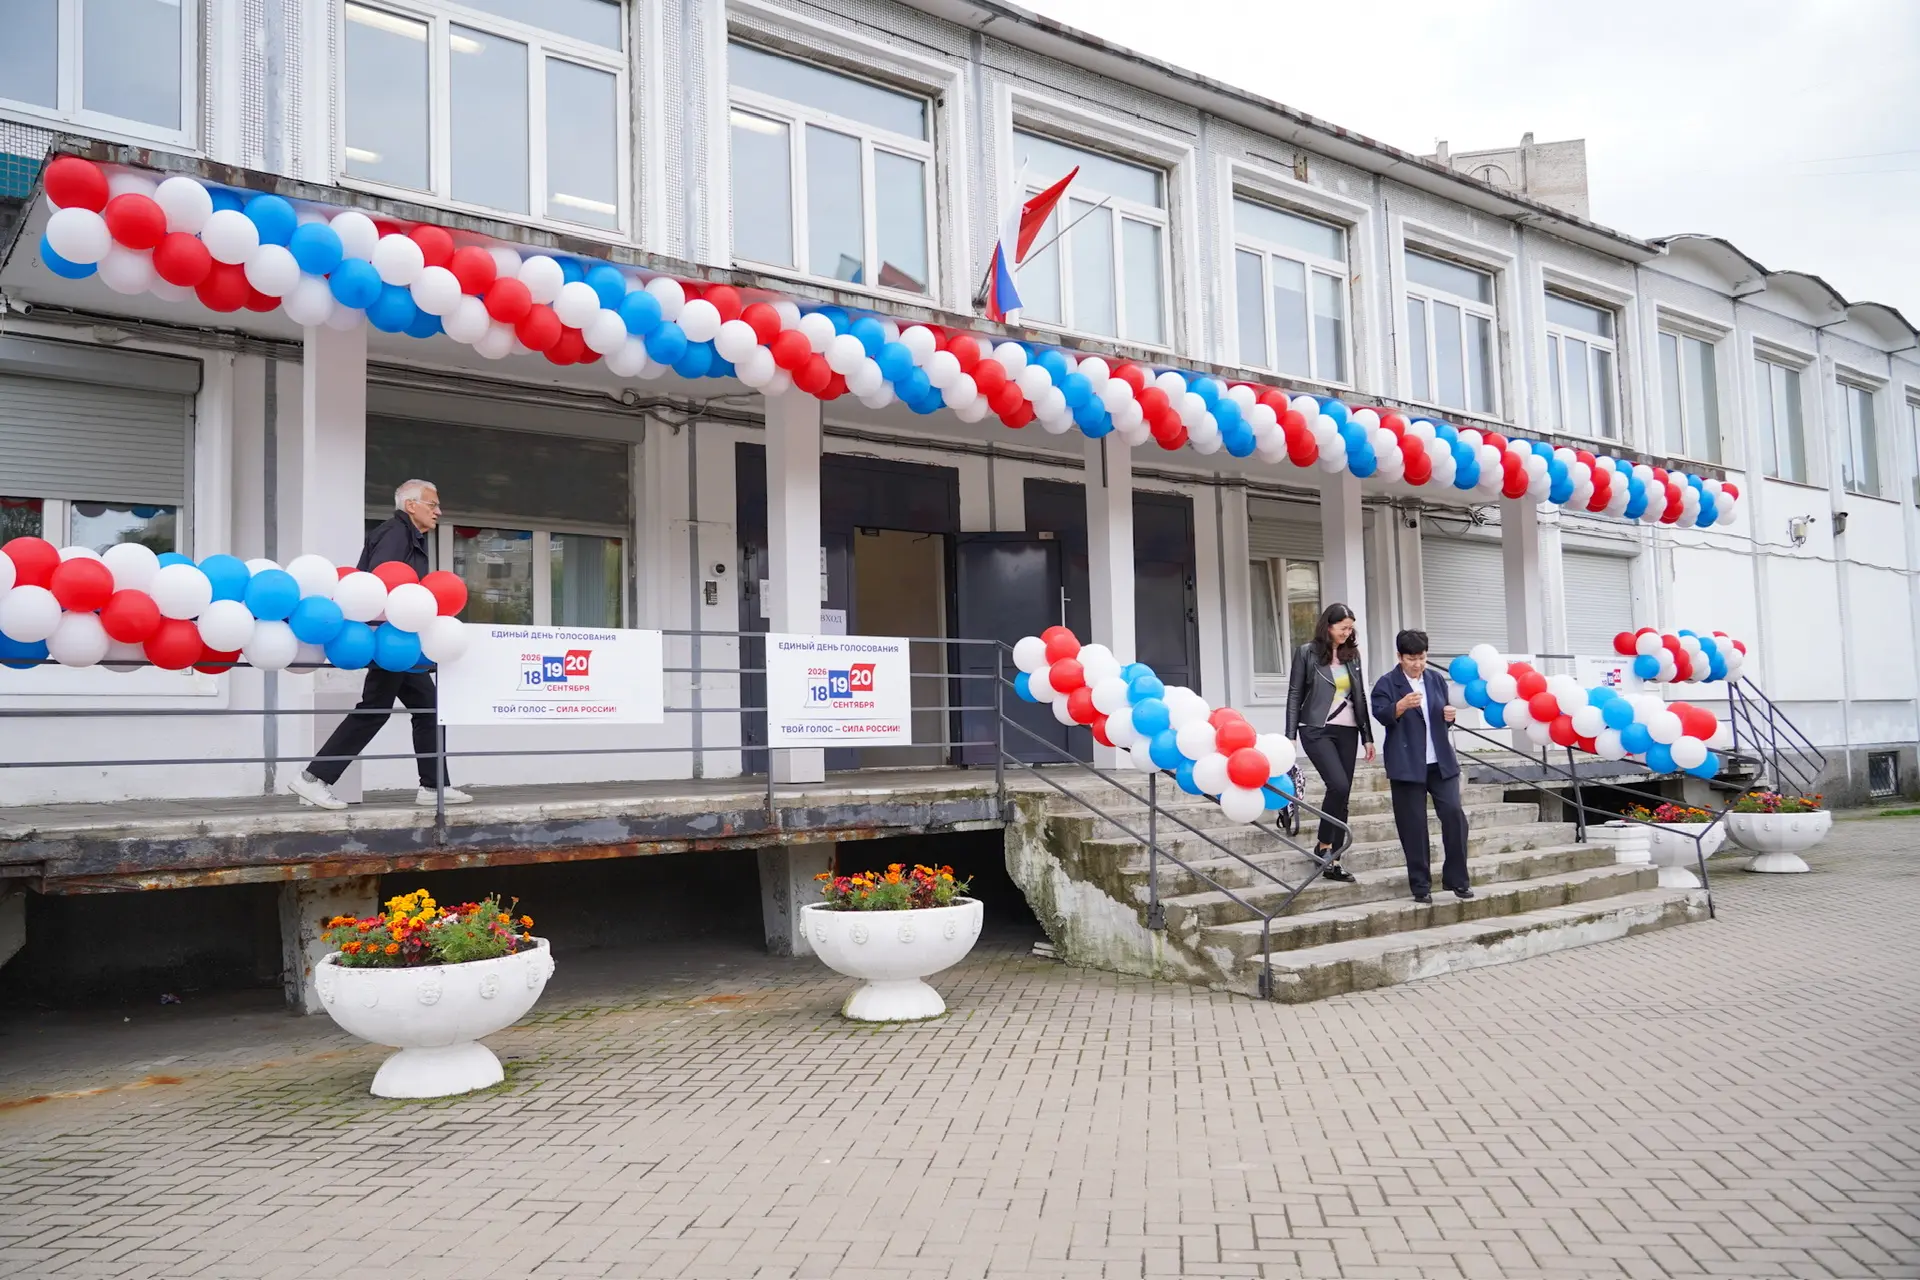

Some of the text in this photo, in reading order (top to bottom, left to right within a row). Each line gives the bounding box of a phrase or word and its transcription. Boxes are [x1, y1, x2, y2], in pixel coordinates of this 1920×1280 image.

[820, 614, 842, 623] ВХОД
[491, 630, 617, 641] ЕДИНЫЙ ДЕНЬ ГОЛОСОВАНИЯ
[778, 641, 899, 653] ЕДИНЫЙ ДЕНЬ ГОЛОСОВАНИЯ
[521, 653, 541, 661] 2026
[523, 655, 588, 685] 18 19 20
[807, 667, 827, 676] 2026
[546, 684, 590, 692] СЕНТЯБРЯ
[811, 669, 872, 701] 18 19 20
[492, 704, 516, 713] ТВОЙ
[518, 705, 547, 713] ГОЛОС
[556, 705, 579, 713] СИЛА
[581, 705, 617, 713] РОССИИ!
[832, 701, 875, 709] СЕНТЯБРЯ
[781, 724, 804, 733] ТВОЙ
[805, 725, 834, 733] ГОЛОС
[842, 725, 865, 733] СИЛА
[866, 724, 901, 733] РОССИИ!
